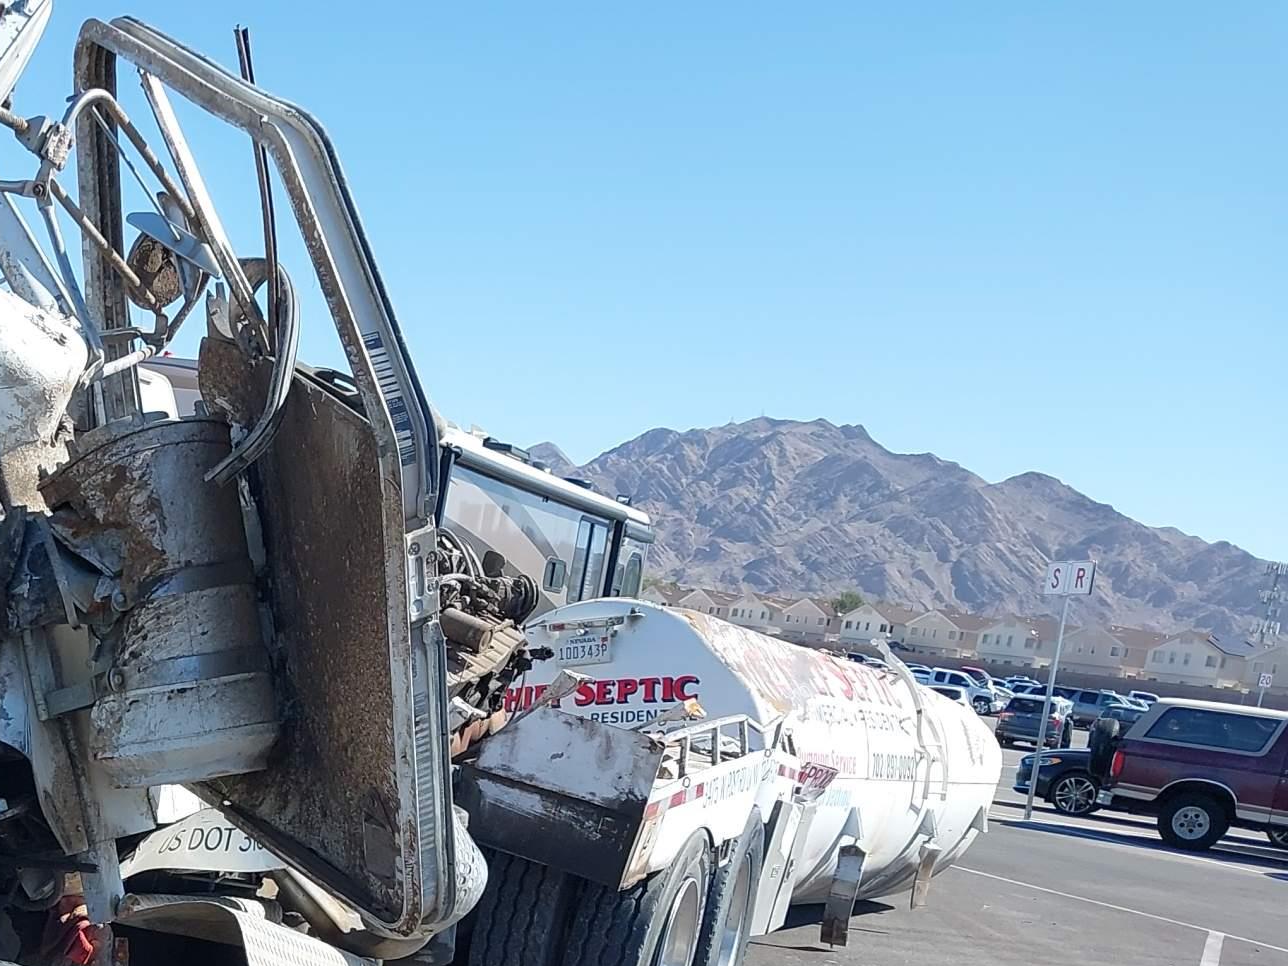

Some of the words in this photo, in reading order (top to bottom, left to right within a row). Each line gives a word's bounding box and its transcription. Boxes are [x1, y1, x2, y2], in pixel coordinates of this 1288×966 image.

[1050, 567, 1062, 589] S
[1074, 567, 1087, 589] R
[573, 676, 700, 707] SEPTIC
[188, 826, 237, 852] DOT
